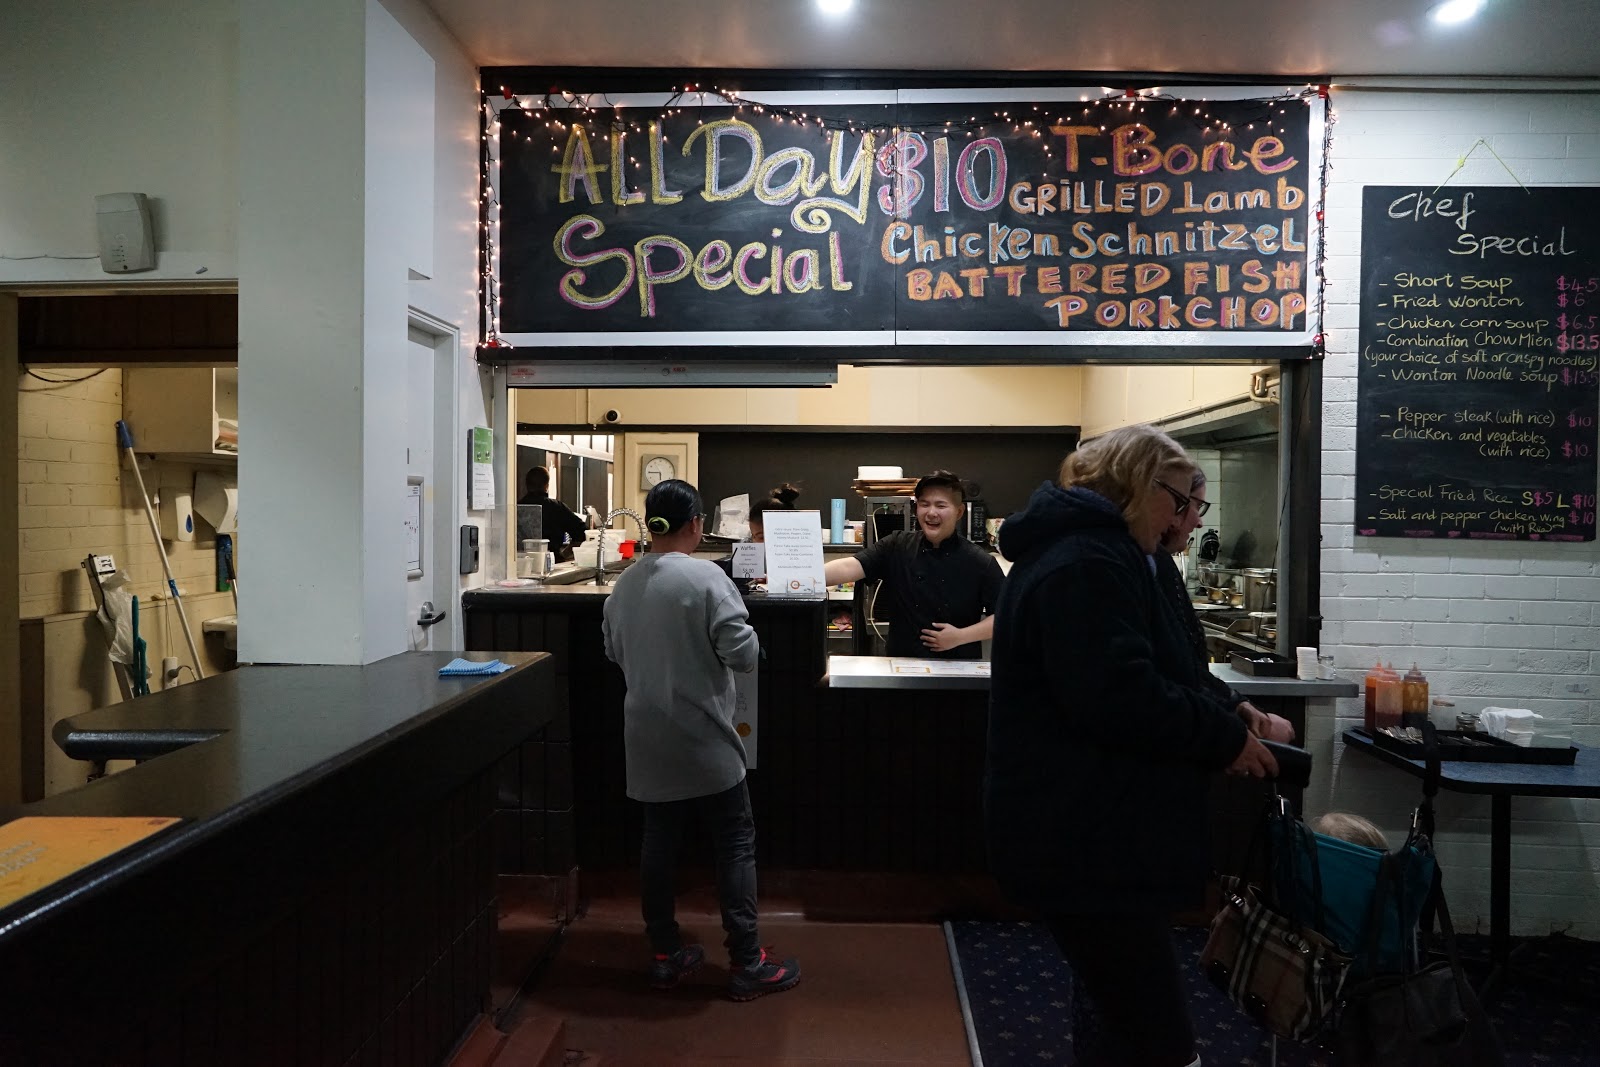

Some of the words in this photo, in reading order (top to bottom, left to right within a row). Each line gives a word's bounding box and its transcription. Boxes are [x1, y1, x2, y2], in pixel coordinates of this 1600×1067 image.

[1049, 124, 1299, 176] T-Bone
[551, 121, 683, 205] ALL
[682, 119, 876, 233] Day
[877, 128, 1007, 219] $10
[1172, 177, 1305, 214] Lamb
[1388, 191, 1476, 230] Chef
[1448, 226, 1577, 259] Special
[553, 214, 853, 317] Special
[907, 262, 1171, 301] BATTERED
[1184, 259, 1300, 295] FISH
[1393, 272, 1454, 288] Short
[1392, 293, 1442, 309] Fried
[1460, 318, 1502, 329] corn
[1505, 319, 1549, 333] soup
[1474, 331, 1517, 346] Chow
[1519, 333, 1553, 348] Mien
[1556, 331, 1600, 354] $13.5
[1364, 345, 1398, 367] (your
[1400, 350, 1440, 364] choice
[1445, 349, 1459, 363] of
[1462, 349, 1487, 363] soft
[1491, 352, 1506, 362] or
[1391, 367, 1457, 381] Wonton
[1466, 366, 1513, 380] Noodle
[1520, 370, 1558, 392] soup
[1398, 406, 1447, 427] Pepper
[1459, 427, 1482, 441] and
[1487, 430, 1546, 447] vegetables
[1379, 484, 1434, 501] Special
[1438, 483, 1476, 501] Fried
[1483, 488, 1513, 504] Rice
[1556, 493, 1571, 508] L
[1379, 508, 1407, 520] Salt
[1411, 508, 1437, 520] and
[1440, 511, 1487, 528] pepper
